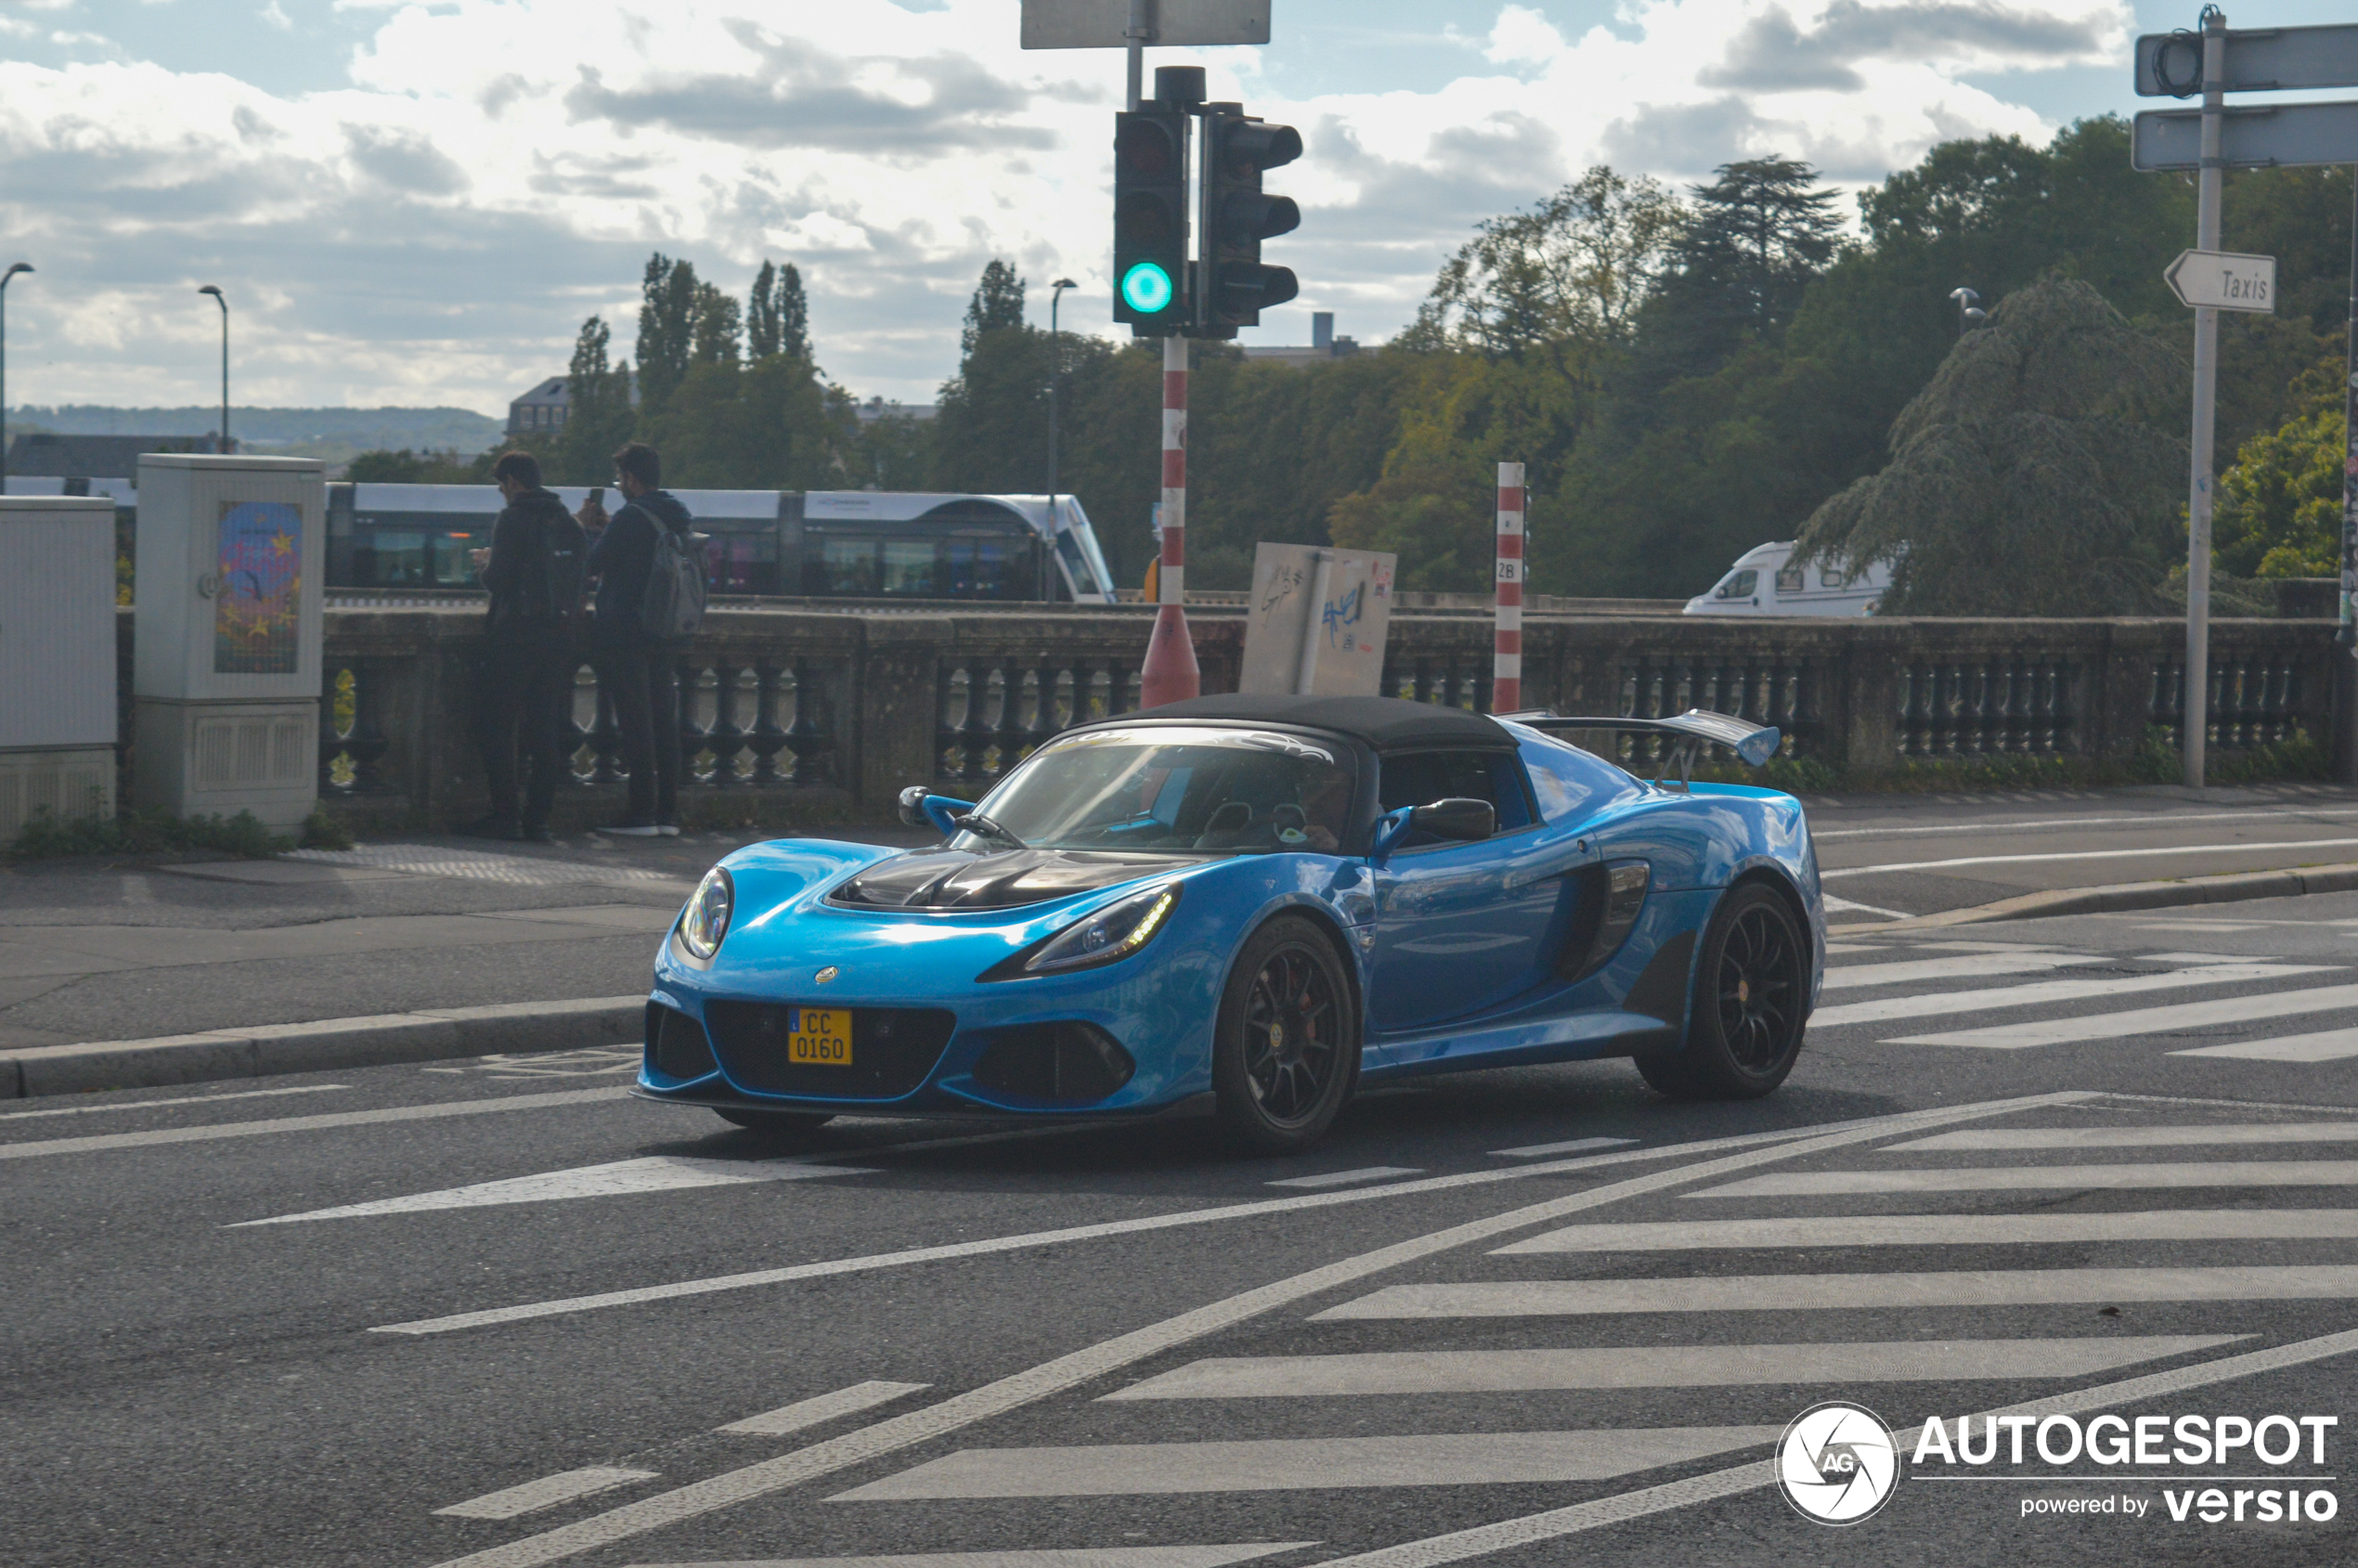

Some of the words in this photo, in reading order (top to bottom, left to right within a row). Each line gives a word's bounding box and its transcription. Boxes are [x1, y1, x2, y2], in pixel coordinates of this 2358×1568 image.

[2222, 270, 2267, 301] Taxis
[807, 1013, 831, 1034] CC
[797, 1036, 844, 1059] 0160
